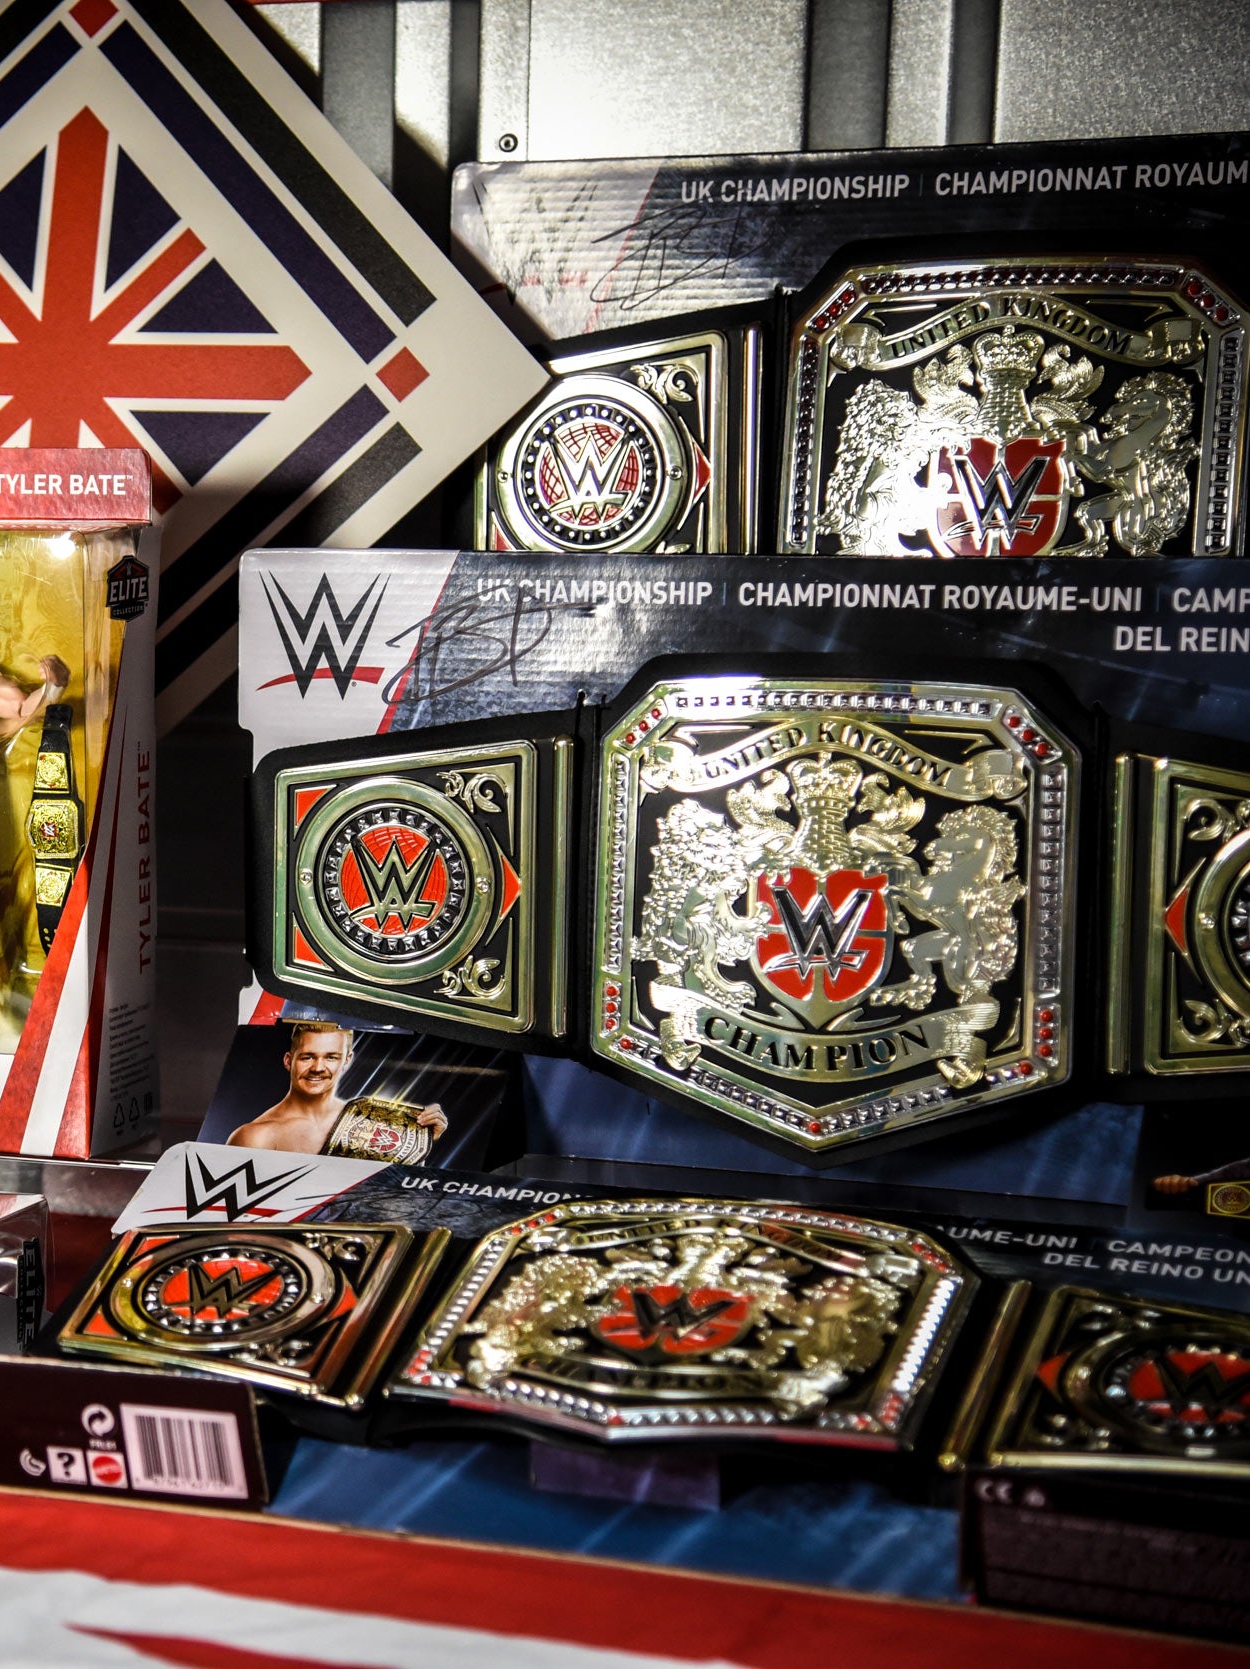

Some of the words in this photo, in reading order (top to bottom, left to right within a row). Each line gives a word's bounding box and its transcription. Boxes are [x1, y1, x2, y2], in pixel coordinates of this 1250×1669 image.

[681, 180, 713, 203] UK
[720, 174, 911, 201] CHAMPIONSHIP
[935, 165, 1128, 196] CHAMPIONNAT
[890, 301, 992, 358] UNITED
[1004, 296, 1135, 354] KINGDOM
[110, 576, 147, 603] ELITE
[477, 578, 511, 602] UK
[519, 580, 713, 606] CHAMPIONSHIP
[738, 582, 935, 609] CHAMPIONNAT
[943, 585, 1142, 612] ROYAUME-UNI
[1114, 625, 1171, 652] DEL
[701, 724, 807, 780] UNITED
[817, 721, 952, 788] KINGDOM
[136, 857, 151, 975] TYLER
[703, 1014, 930, 1071] CHAMPION
[401, 1175, 437, 1193] UK
[1043, 1252, 1101, 1270] DEL
[1110, 1258, 1204, 1280] REINO
